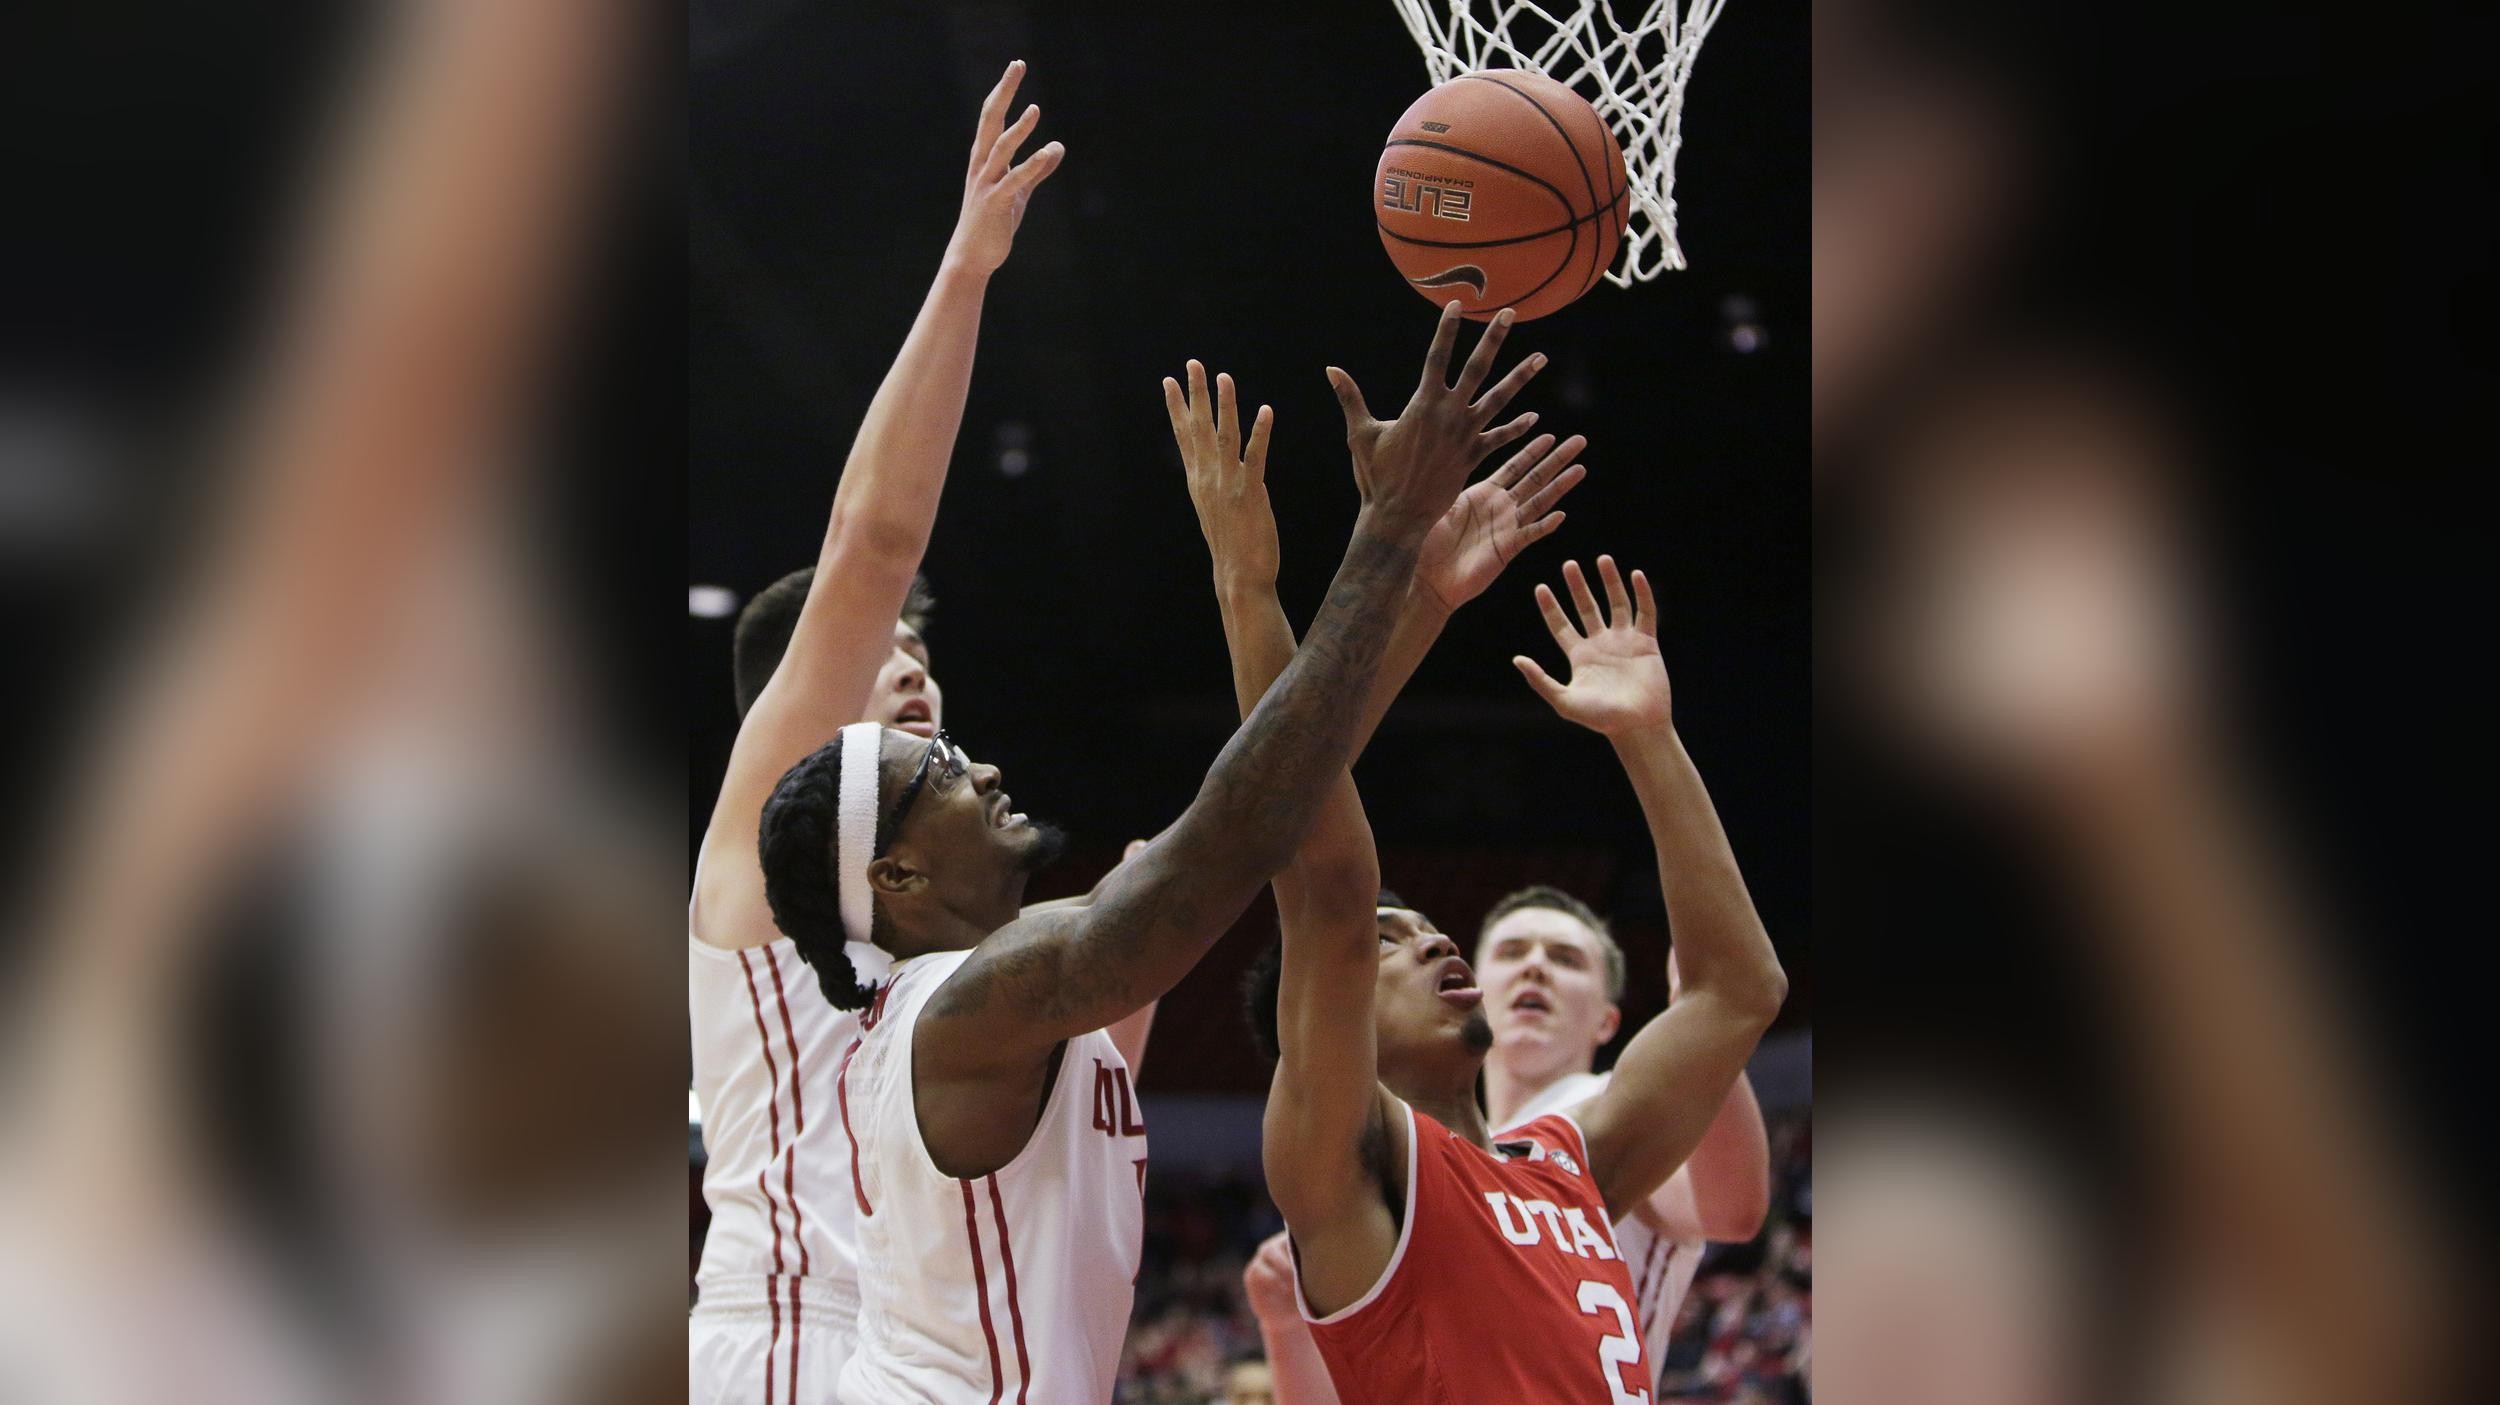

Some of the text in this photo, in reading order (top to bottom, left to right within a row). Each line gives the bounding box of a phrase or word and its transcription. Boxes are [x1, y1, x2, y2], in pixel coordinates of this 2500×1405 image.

[1384, 177, 1472, 221] ELITE
[1387, 168, 1473, 187] CHAMPIONSHIP
[1576, 1280, 1649, 1405] 2
